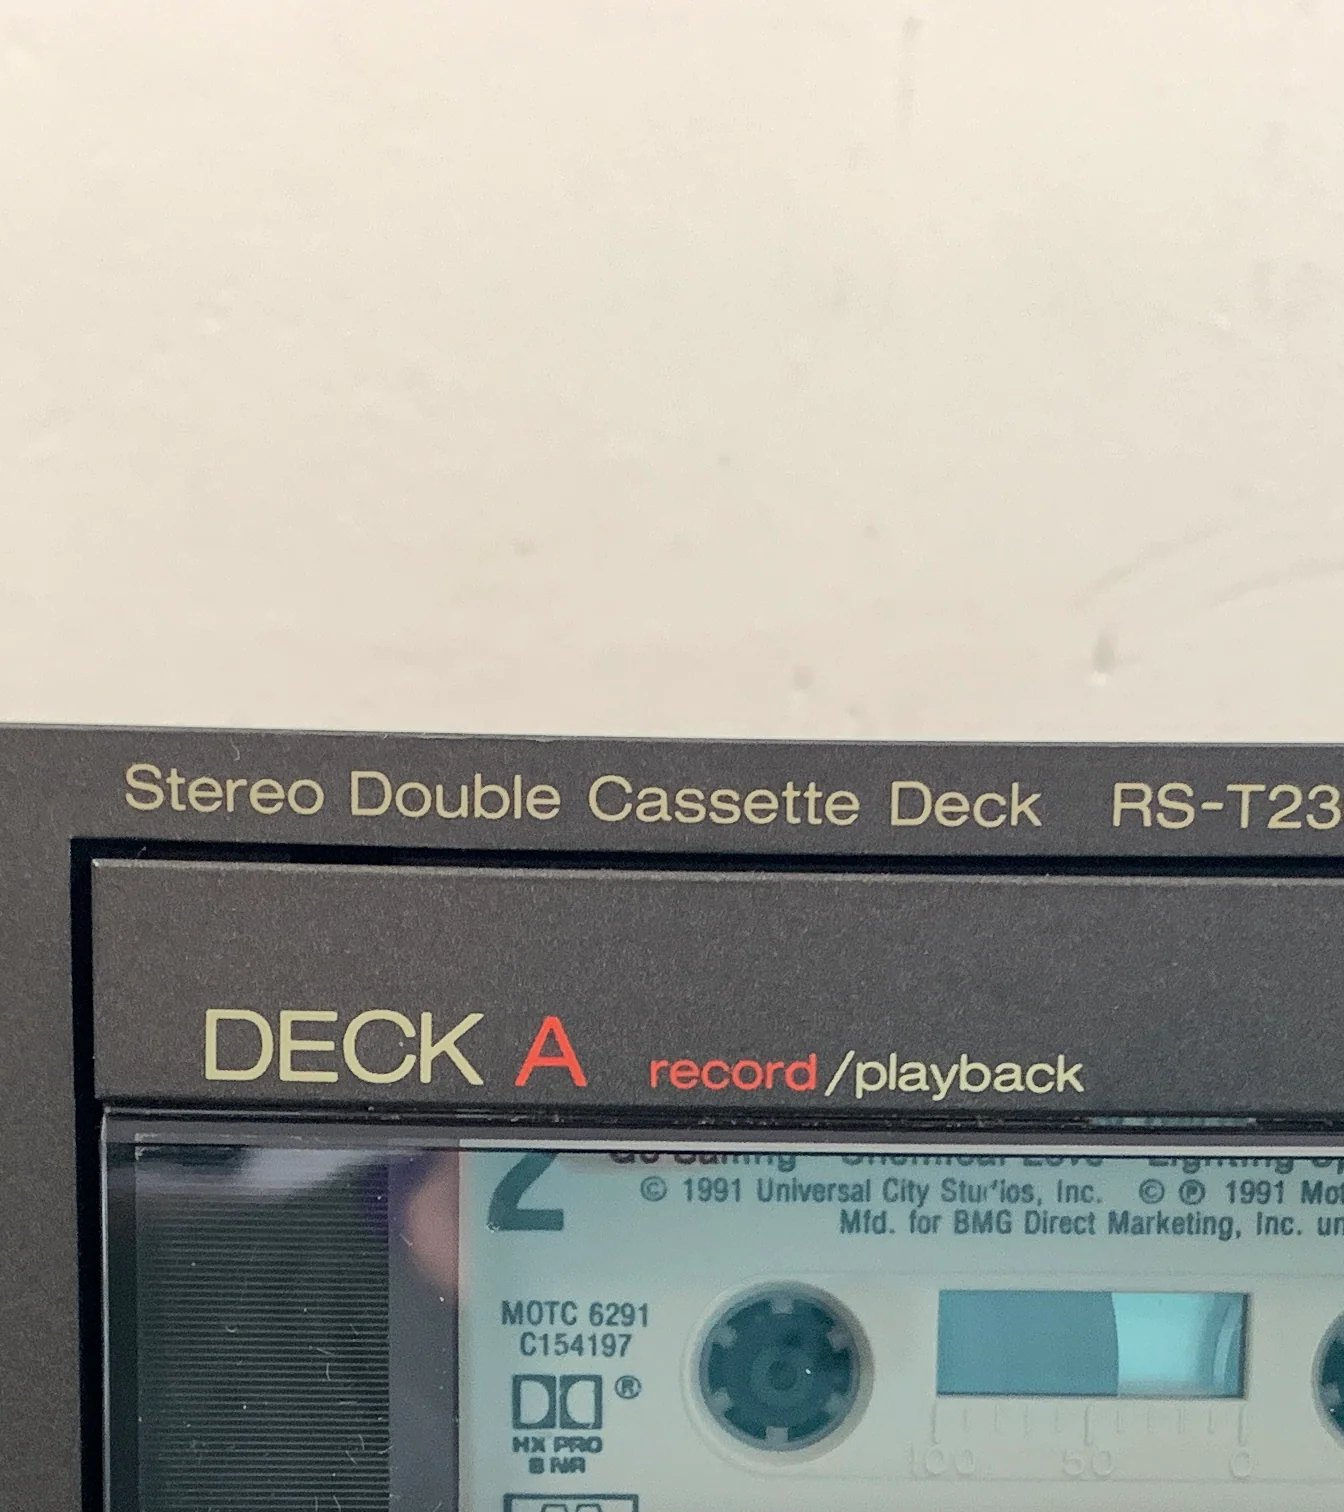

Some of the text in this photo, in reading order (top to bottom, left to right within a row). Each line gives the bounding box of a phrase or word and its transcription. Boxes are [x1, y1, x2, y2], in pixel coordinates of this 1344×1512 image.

[126, 764, 324, 815] Stereo
[351, 771, 560, 820] Double
[589, 775, 859, 825] Cassette
[891, 781, 1041, 828] Deck
[205, 1009, 587, 1086] DECK A
[651, 1050, 1084, 1101] record/playback
[684, 1177, 740, 1202] 1991
[757, 1177, 871, 1203] Universal
[883, 1177, 929, 1208] City
[1057, 1180, 1101, 1203] Inc.
[1227, 1180, 1284, 1204] 1991
[840, 1209, 894, 1234] Mfd.
[909, 1209, 942, 1234] for
[954, 1209, 1012, 1234] BMG
[1025, 1210, 1095, 1235] Direct
[1109, 1210, 1241, 1241] Marketing,
[1257, 1211, 1302, 1236] Inc.
[502, 1300, 647, 1327] MOTC 6291
[520, 1331, 632, 1357] C154197
[513, 1436, 603, 1453] HX PRO
